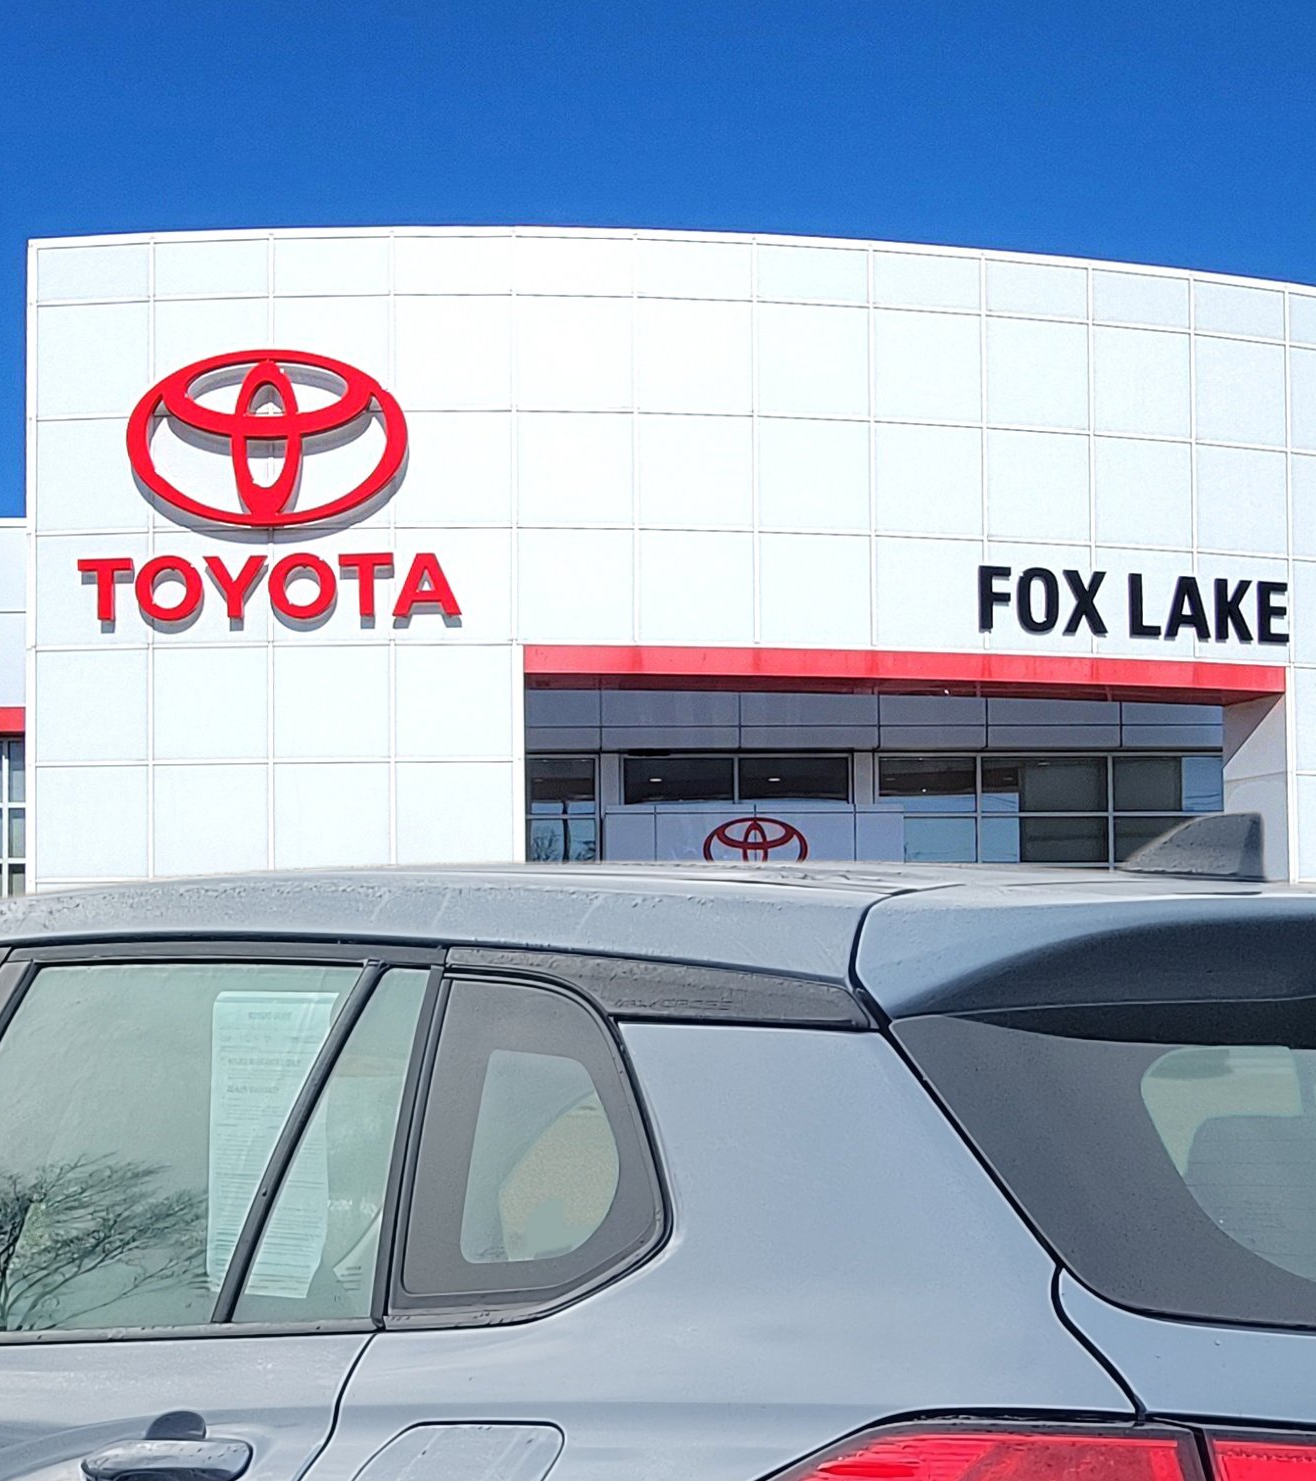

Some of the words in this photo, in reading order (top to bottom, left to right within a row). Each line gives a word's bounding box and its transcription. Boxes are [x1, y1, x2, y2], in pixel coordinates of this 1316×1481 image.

[77, 552, 463, 626] TOYOTA
[978, 564, 1109, 636] FOX
[1127, 572, 1290, 645] LAKE
